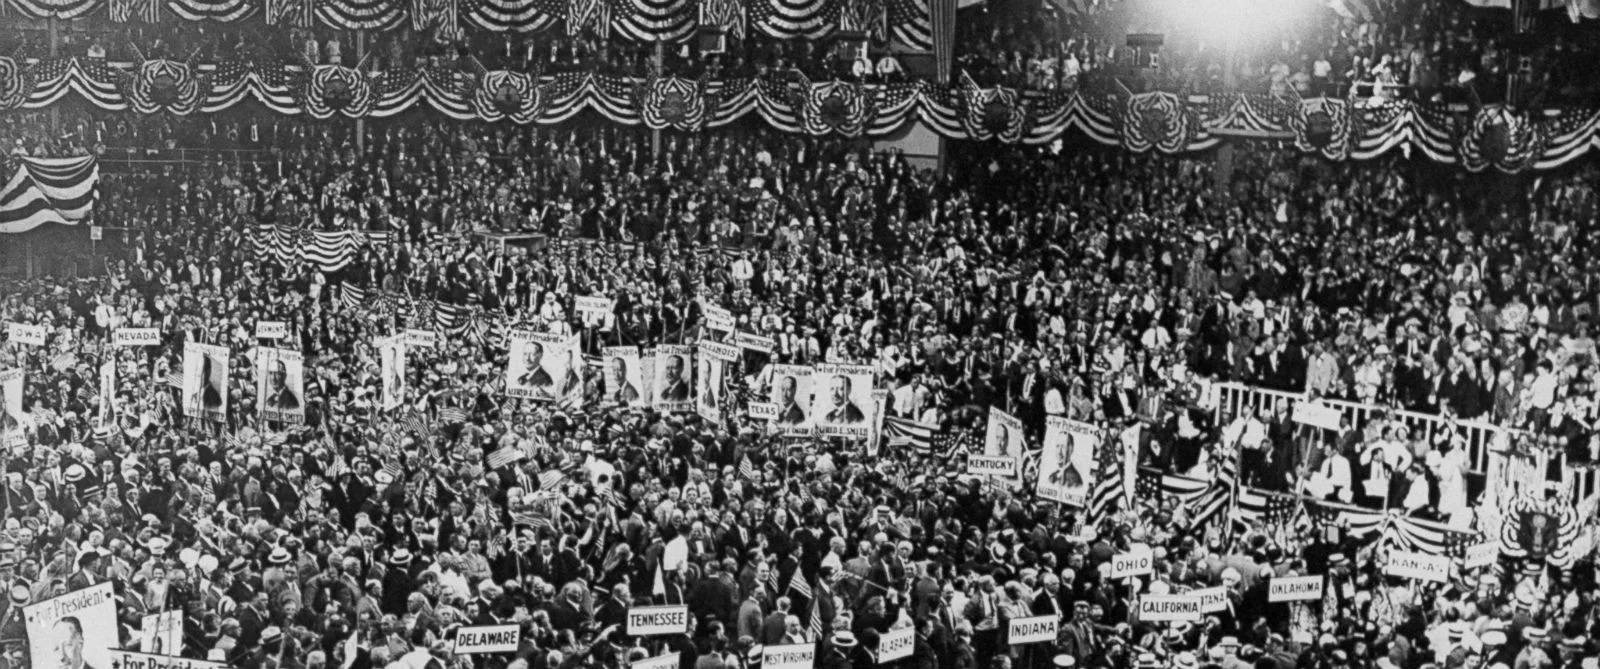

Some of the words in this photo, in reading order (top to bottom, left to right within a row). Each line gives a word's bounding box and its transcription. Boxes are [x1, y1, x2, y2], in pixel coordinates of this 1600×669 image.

[11, 328, 41, 339] OWA
[118, 331, 157, 341] NEVADA
[702, 343, 736, 358] ILLINOIS
[751, 405, 776, 416] TEXAS
[969, 459, 1013, 470] KENTUCKY
[1116, 557, 1148, 572] OHIO
[1392, 558, 1444, 573] KANA
[1271, 580, 1321, 595] OKLAHOMA
[53, 589, 105, 618] President
[1142, 599, 1199, 614] CALIFORNIA
[630, 612, 685, 627] TENNESSEE
[1011, 620, 1056, 638] INDIANA
[458, 630, 518, 647] DELAWARE
[880, 635, 914, 654] ALABAMA
[123, 654, 146, 669] For
[764, 653, 782, 666] WEST
[783, 651, 814, 664] VIRGINIA
